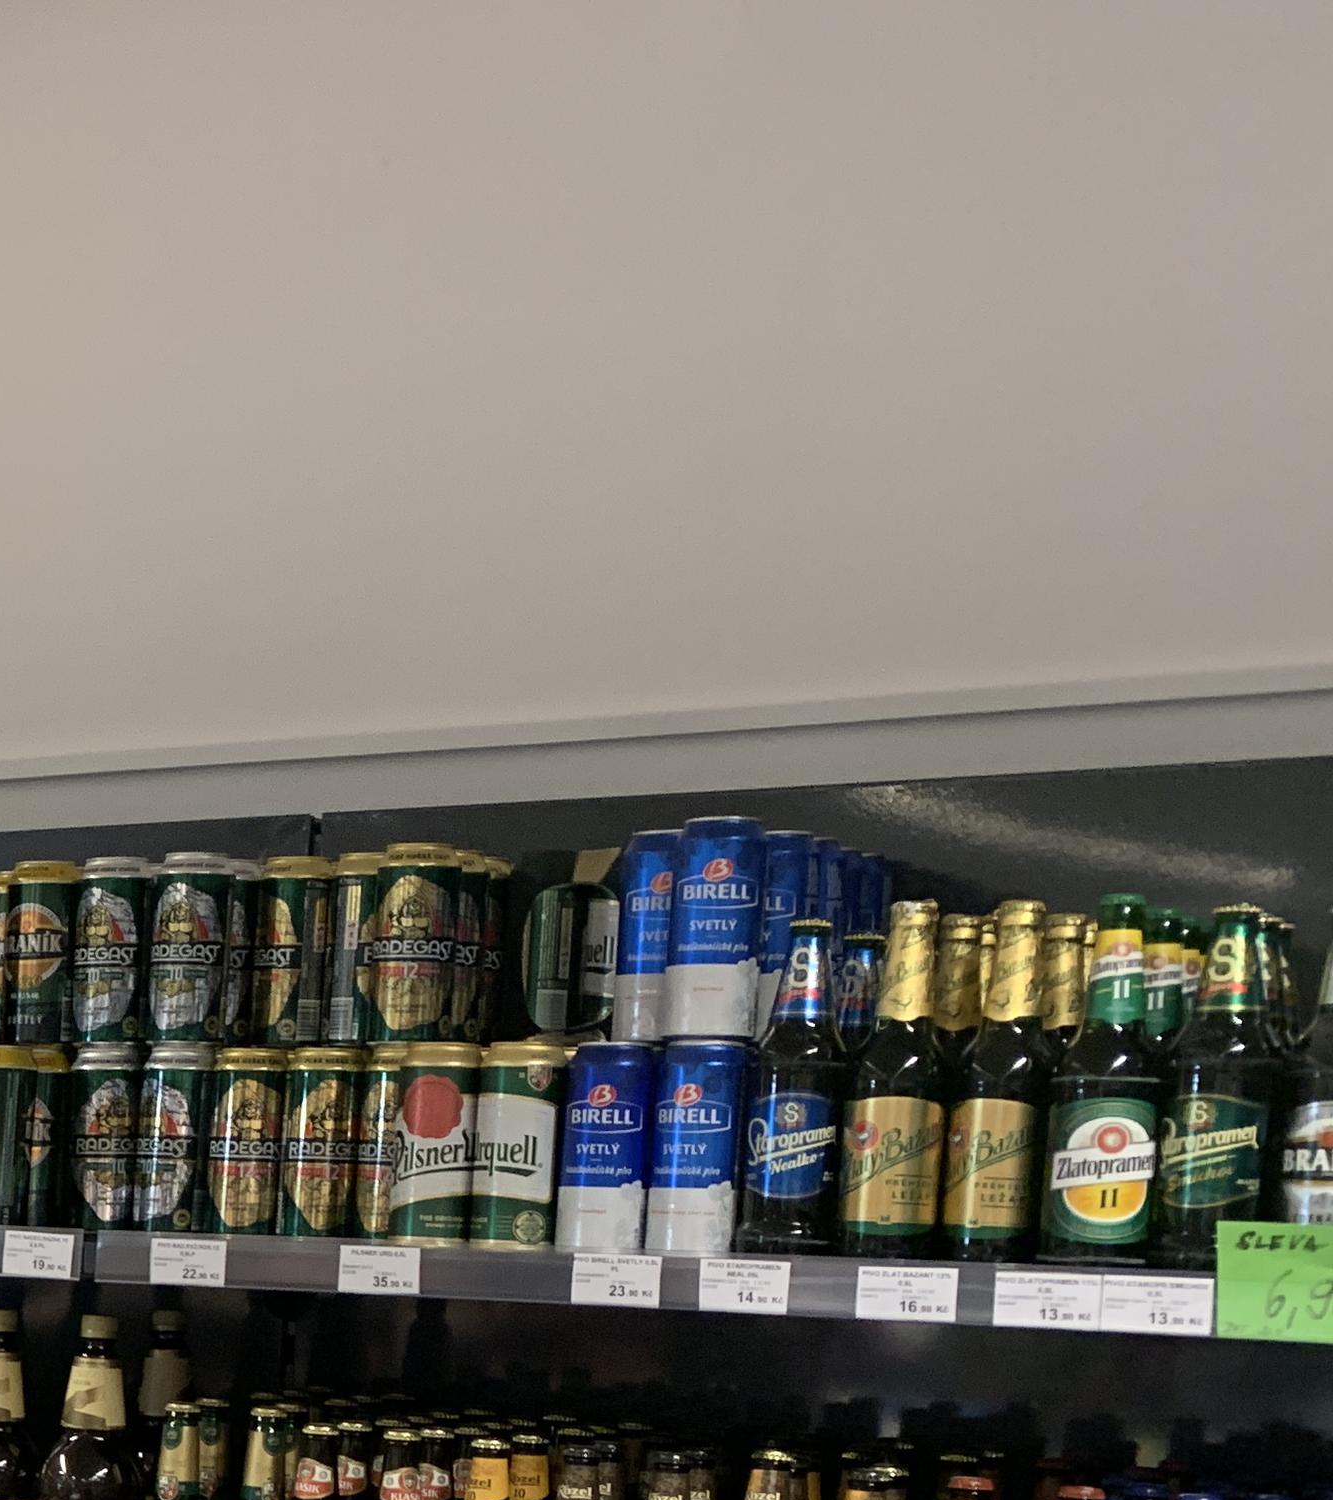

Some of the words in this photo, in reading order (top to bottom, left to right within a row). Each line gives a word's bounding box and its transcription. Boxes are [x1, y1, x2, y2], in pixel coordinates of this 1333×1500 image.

[684, 883, 751, 900] BIRELL
[571, 1108, 634, 1125] BIRELL
[658, 1108, 721, 1125] BIRELL
[1056, 1153, 1155, 1180] Zlatopramen
[1099, 1188, 1118, 1208] 11
[372, 1275, 389, 1288] 35
[899, 1300, 918, 1314] 16
[1148, 1312, 1168, 1325] 13
